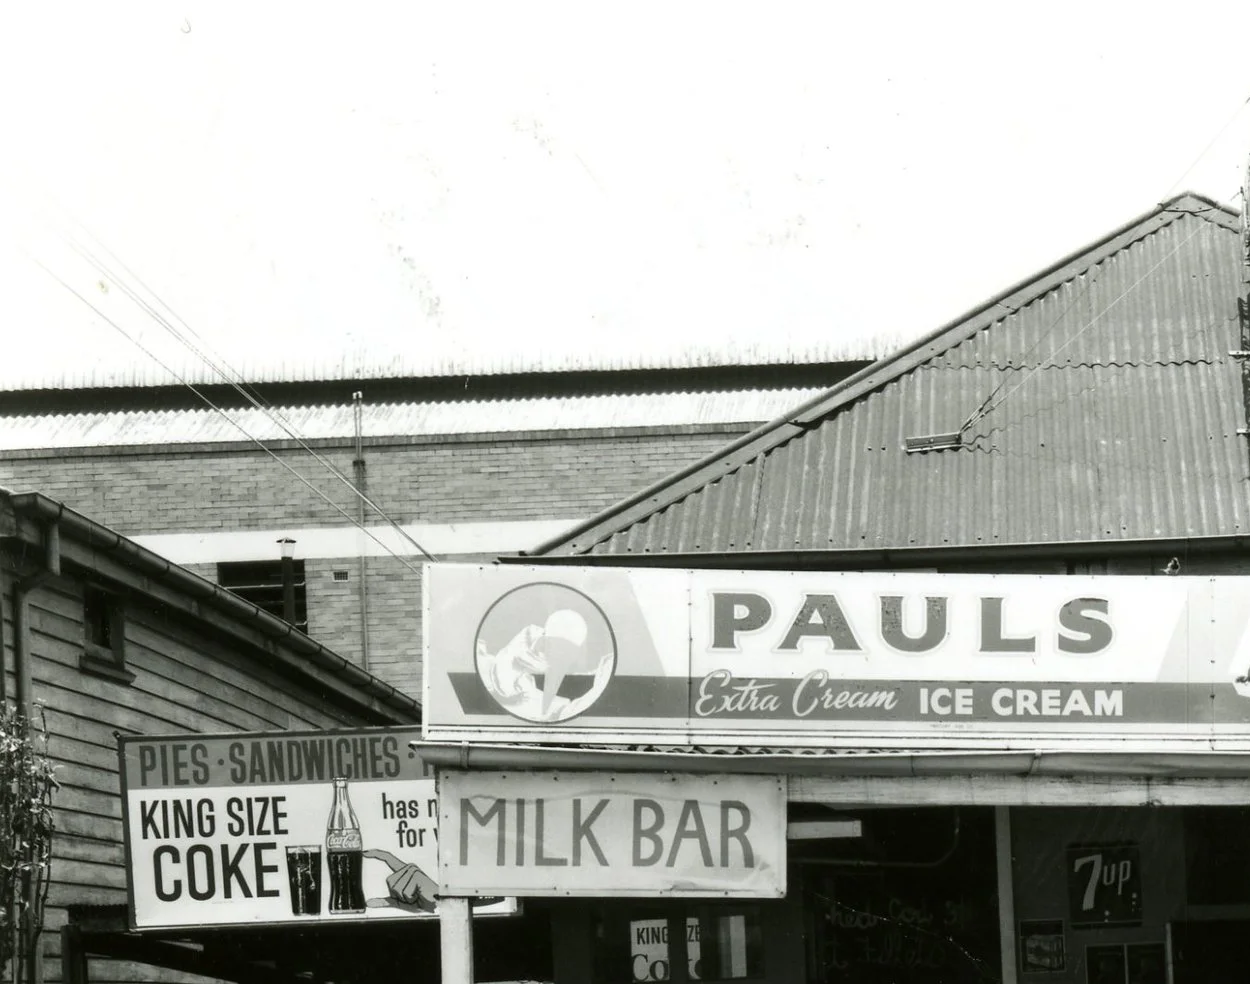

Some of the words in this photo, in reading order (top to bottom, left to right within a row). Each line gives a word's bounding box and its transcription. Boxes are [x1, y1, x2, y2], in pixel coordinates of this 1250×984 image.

[711, 592, 1114, 654] PAULS
[694, 668, 782, 717] Extra
[792, 668, 899, 717] Cream
[919, 687, 974, 716] ICE
[991, 687, 1124, 717] CREAM
[139, 743, 211, 787] PIES
[228, 736, 401, 785] SANDWICHES
[140, 797, 216, 840] KING
[226, 796, 289, 838] SIZE
[381, 792, 419, 820] has
[396, 819, 426, 848] for
[459, 797, 610, 867] MILK
[632, 799, 755, 869] BAR
[152, 841, 281, 903] COKE
